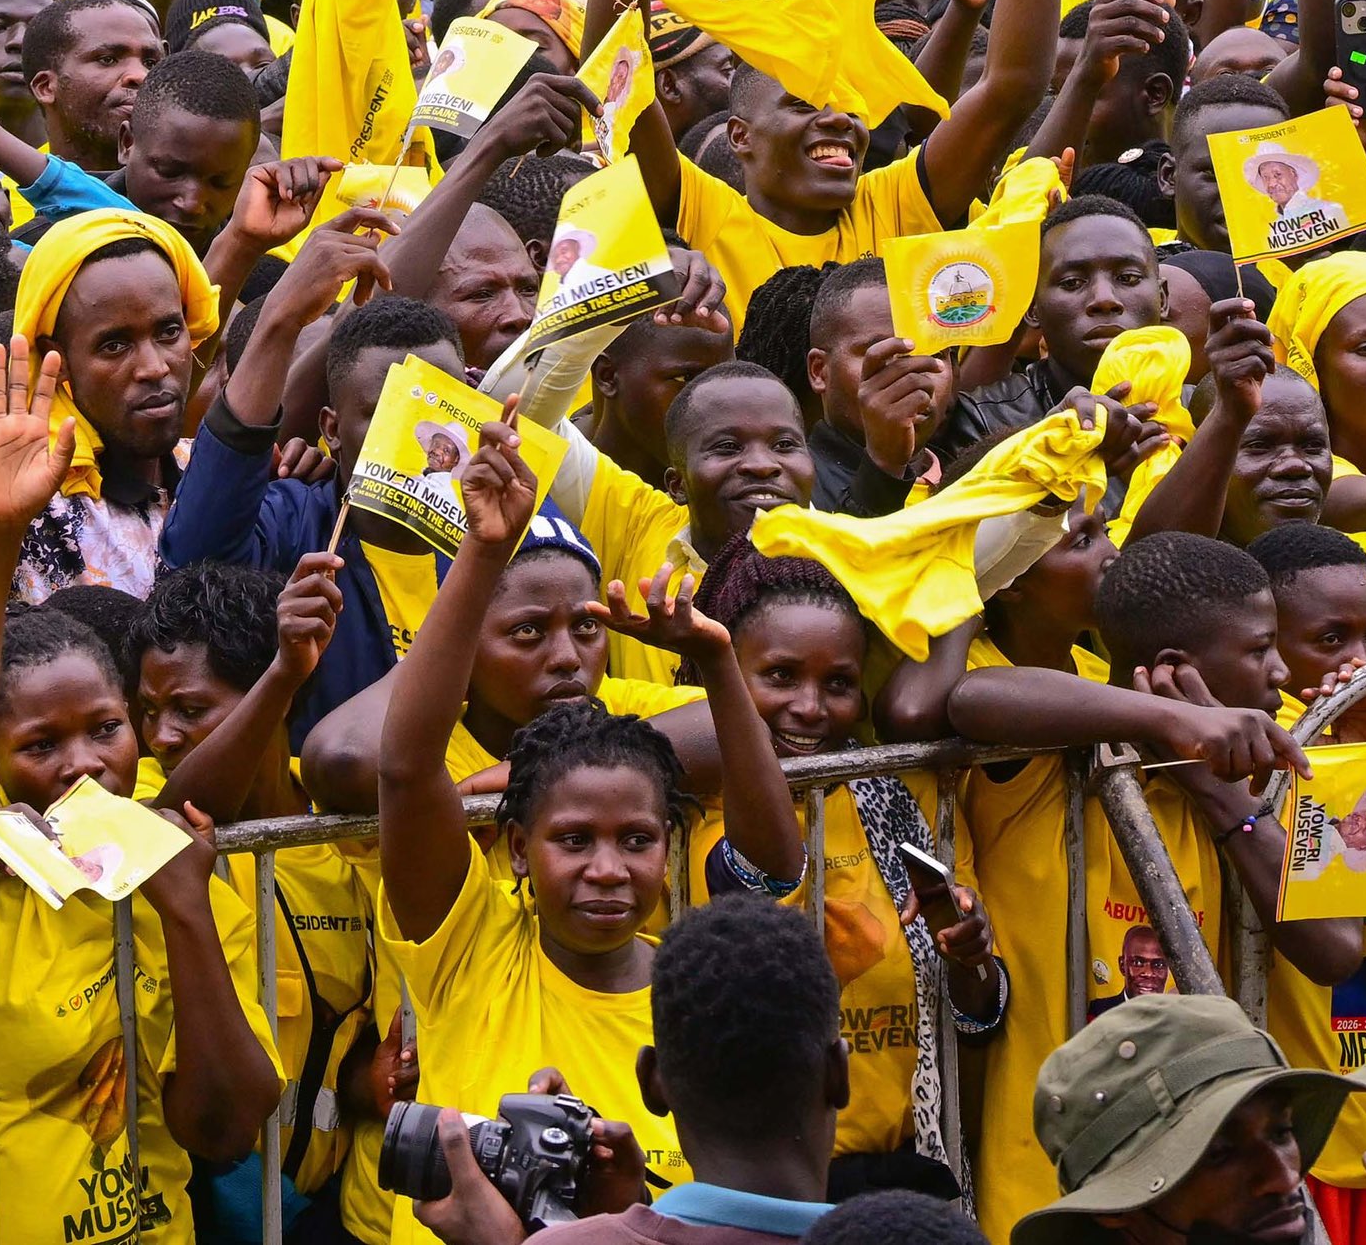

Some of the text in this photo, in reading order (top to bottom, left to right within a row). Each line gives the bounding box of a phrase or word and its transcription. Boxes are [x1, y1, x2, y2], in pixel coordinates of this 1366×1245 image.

[190, 5, 249, 30] LAKERS
[350, 84, 389, 158] PRESIDENT
[1249, 128, 1286, 142] PRESIDENT
[1267, 218, 1340, 250] MUSEVENI
[1269, 209, 1325, 235] YOWERI
[570, 261, 652, 302] MUSEVENI
[589, 281, 650, 310] THE GAINS
[438, 399, 483, 433] PRESIDE
[364, 460, 419, 495] YOWERI
[362, 479, 427, 516] PROTECTING
[427, 510, 444, 527] THE
[1292, 795, 1313, 872] MUSEVENI
[1306, 803, 1326, 862] YOWERI
[668, 1158, 685, 1167] 2031
